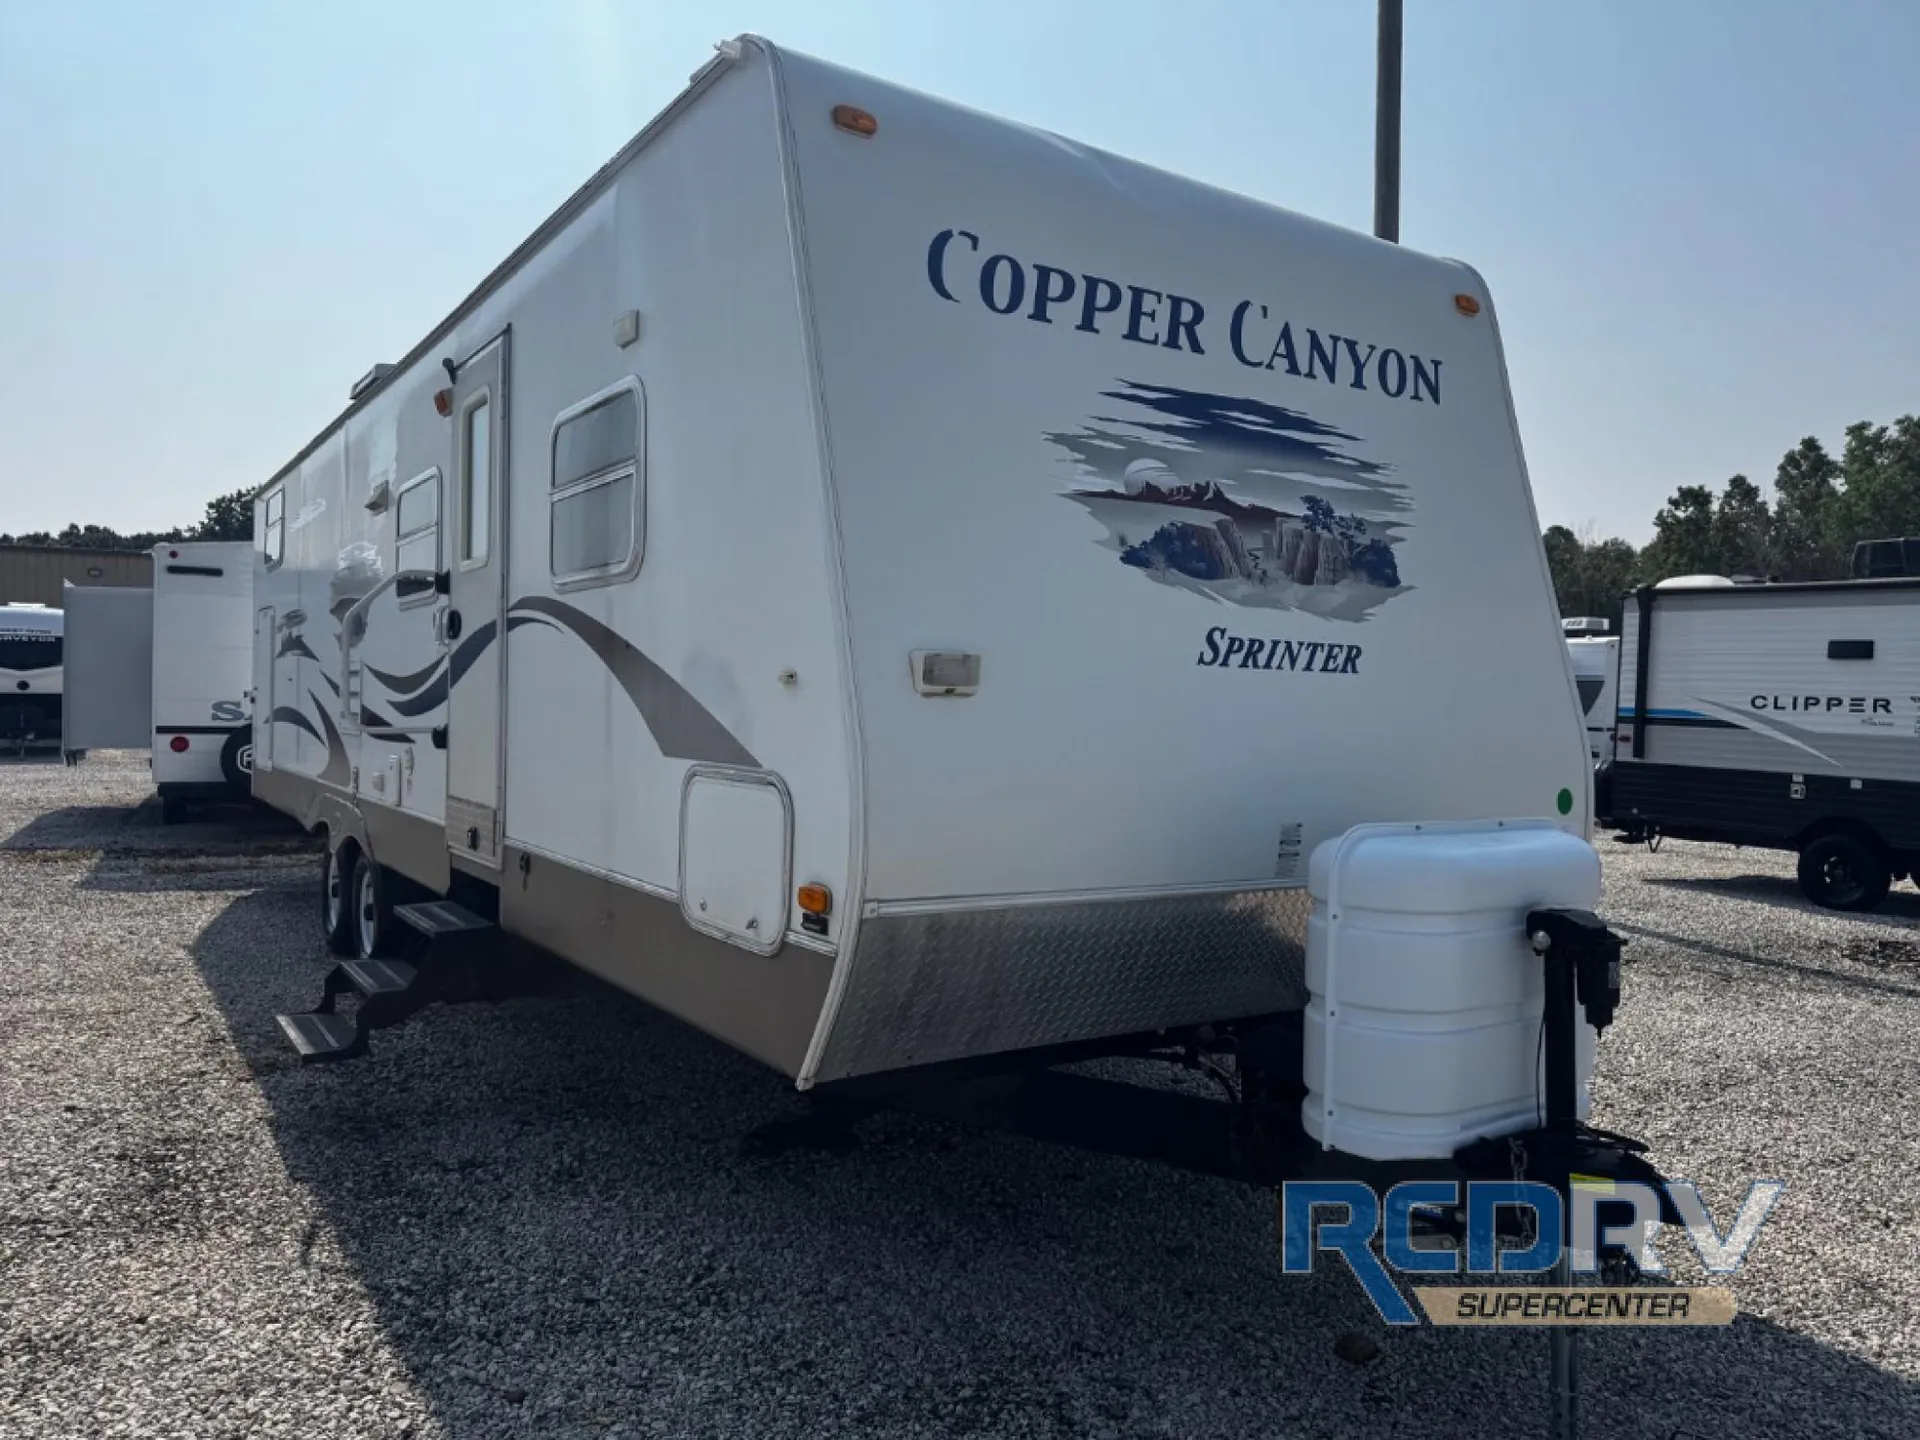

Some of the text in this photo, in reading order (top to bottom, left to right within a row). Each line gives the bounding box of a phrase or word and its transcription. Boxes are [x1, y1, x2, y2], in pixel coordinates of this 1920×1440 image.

[927, 229, 1442, 405] COPPER CANYON
[1198, 627, 1362, 674] SPRINTER
[1750, 695, 1892, 714] CLIPPER
